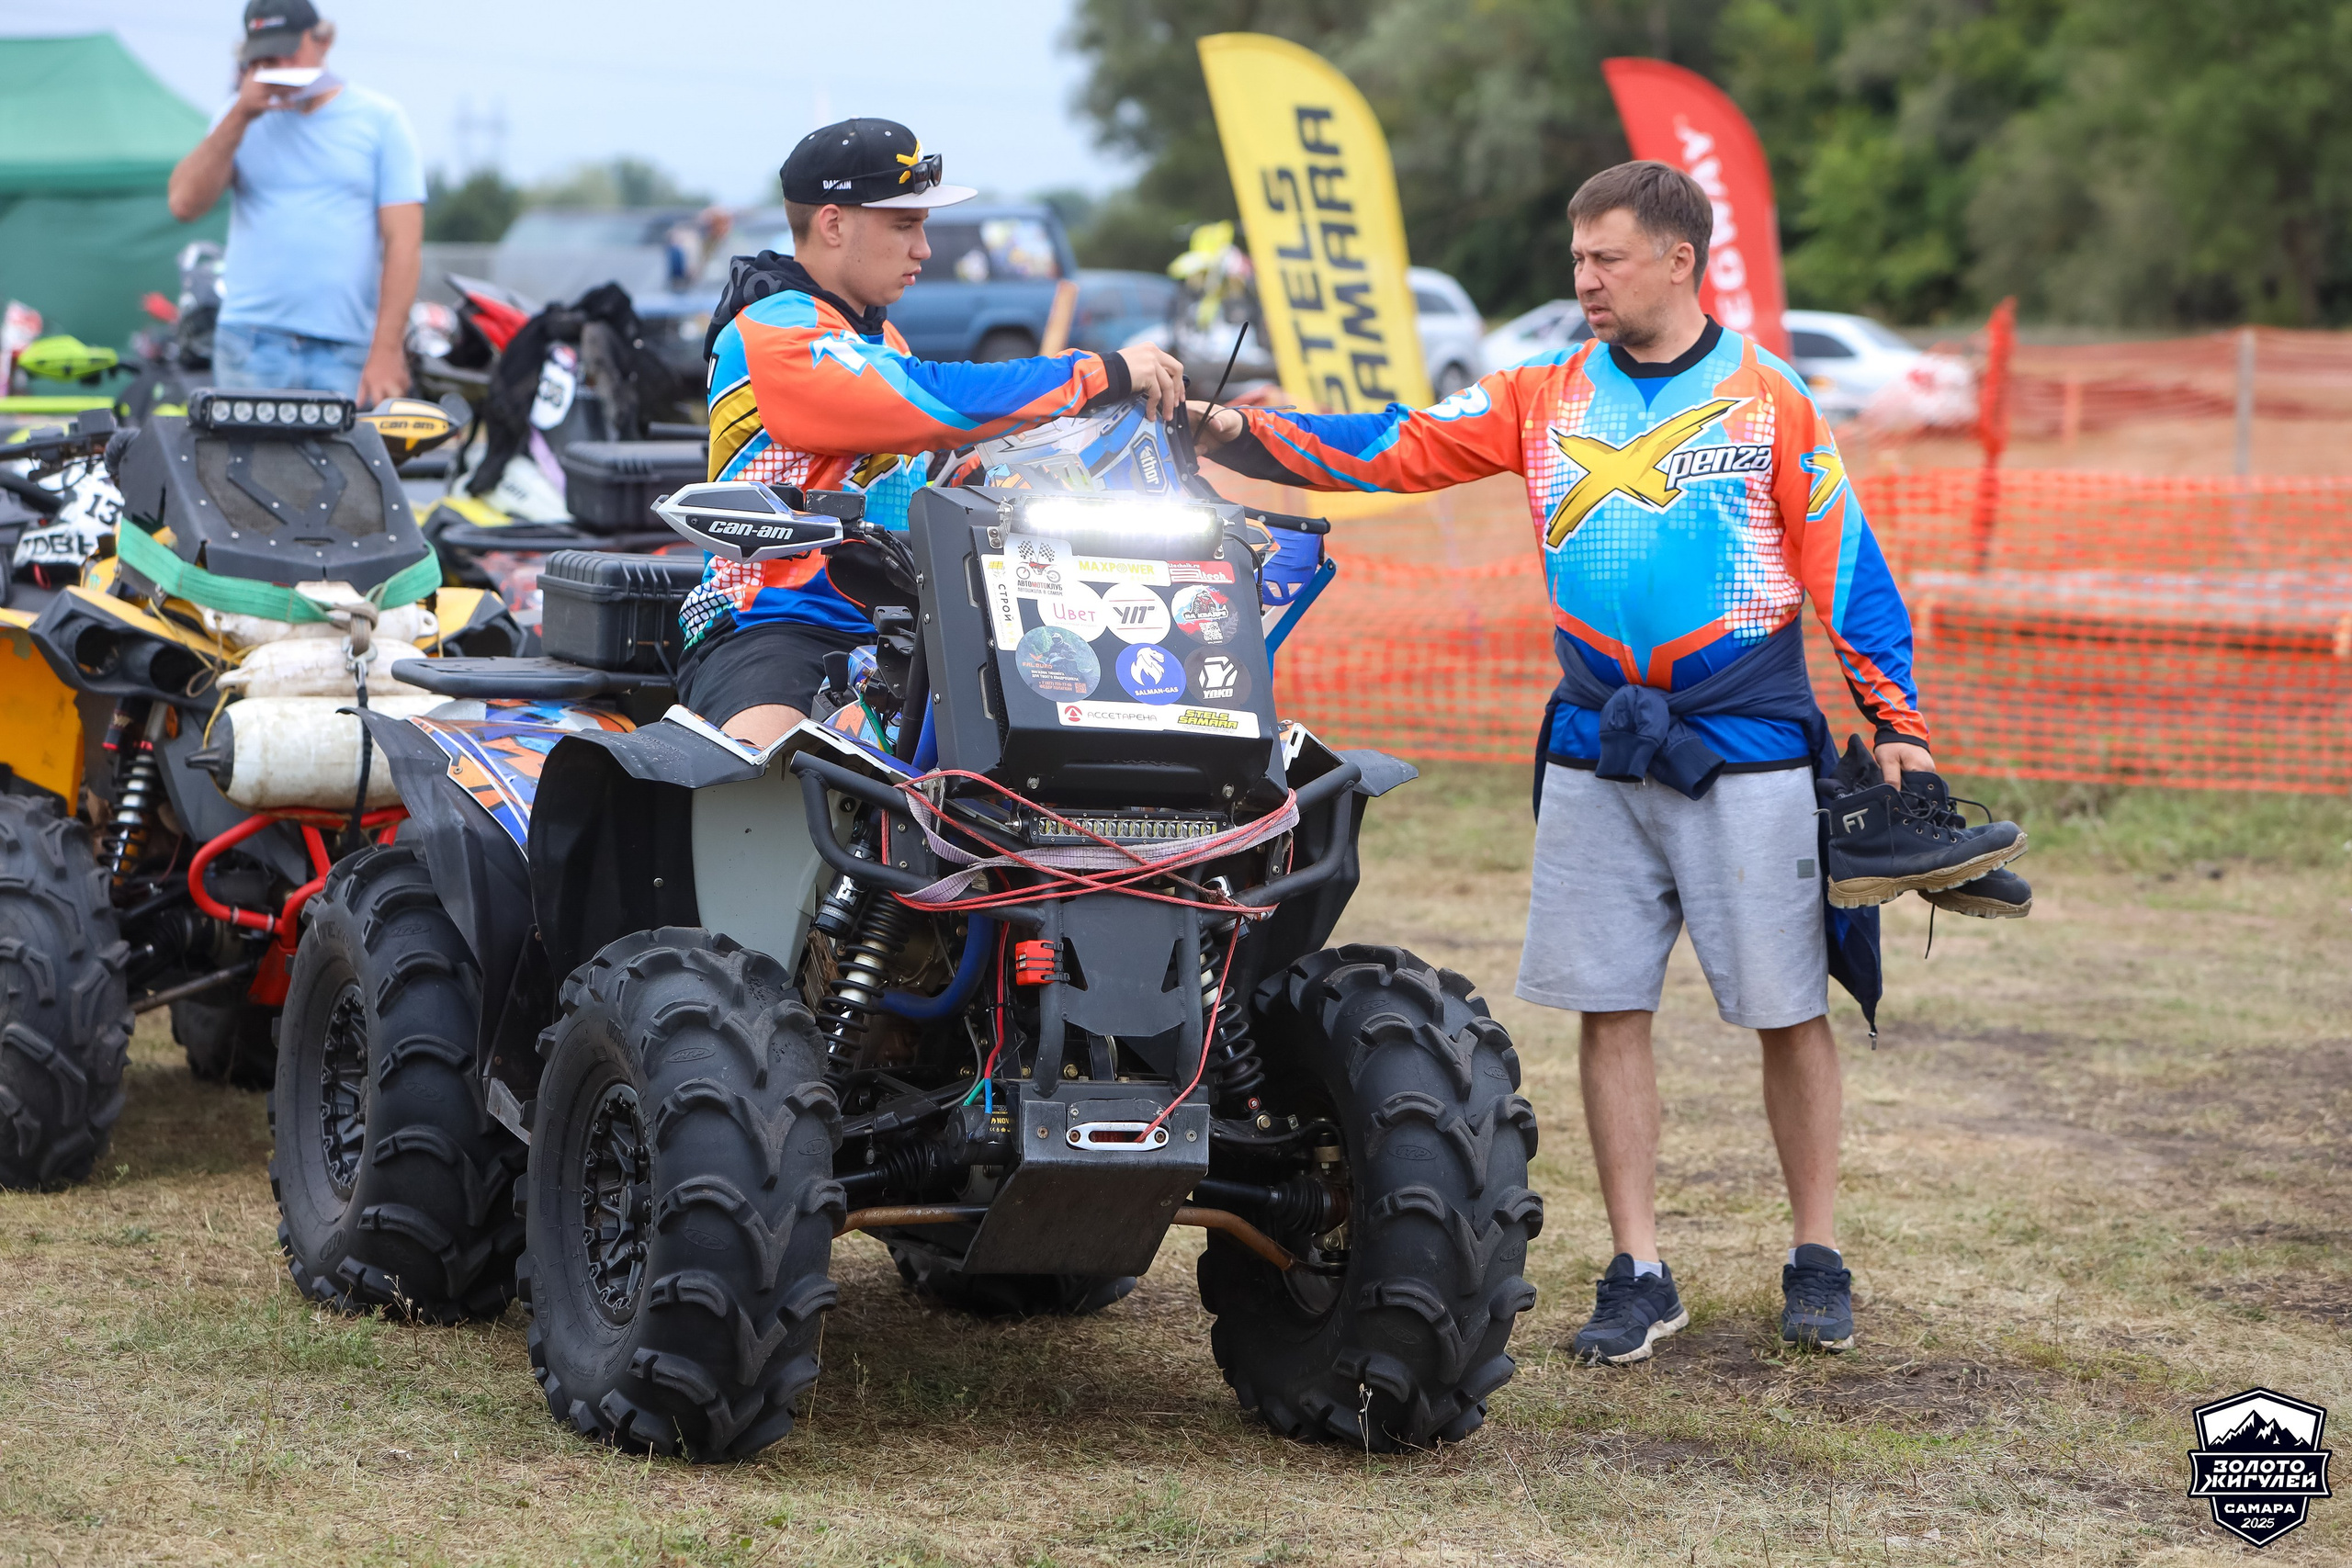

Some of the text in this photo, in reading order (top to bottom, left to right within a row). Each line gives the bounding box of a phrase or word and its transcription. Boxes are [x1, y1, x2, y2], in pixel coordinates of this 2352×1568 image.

[1295, 105, 1397, 404] AMARA
[708, 520, 794, 540] can-am
[1135, 687, 1179, 696] SALMAN-GAS
[1184, 709, 1230, 721] STELS
[1178, 716, 1238, 729] SAMARA
